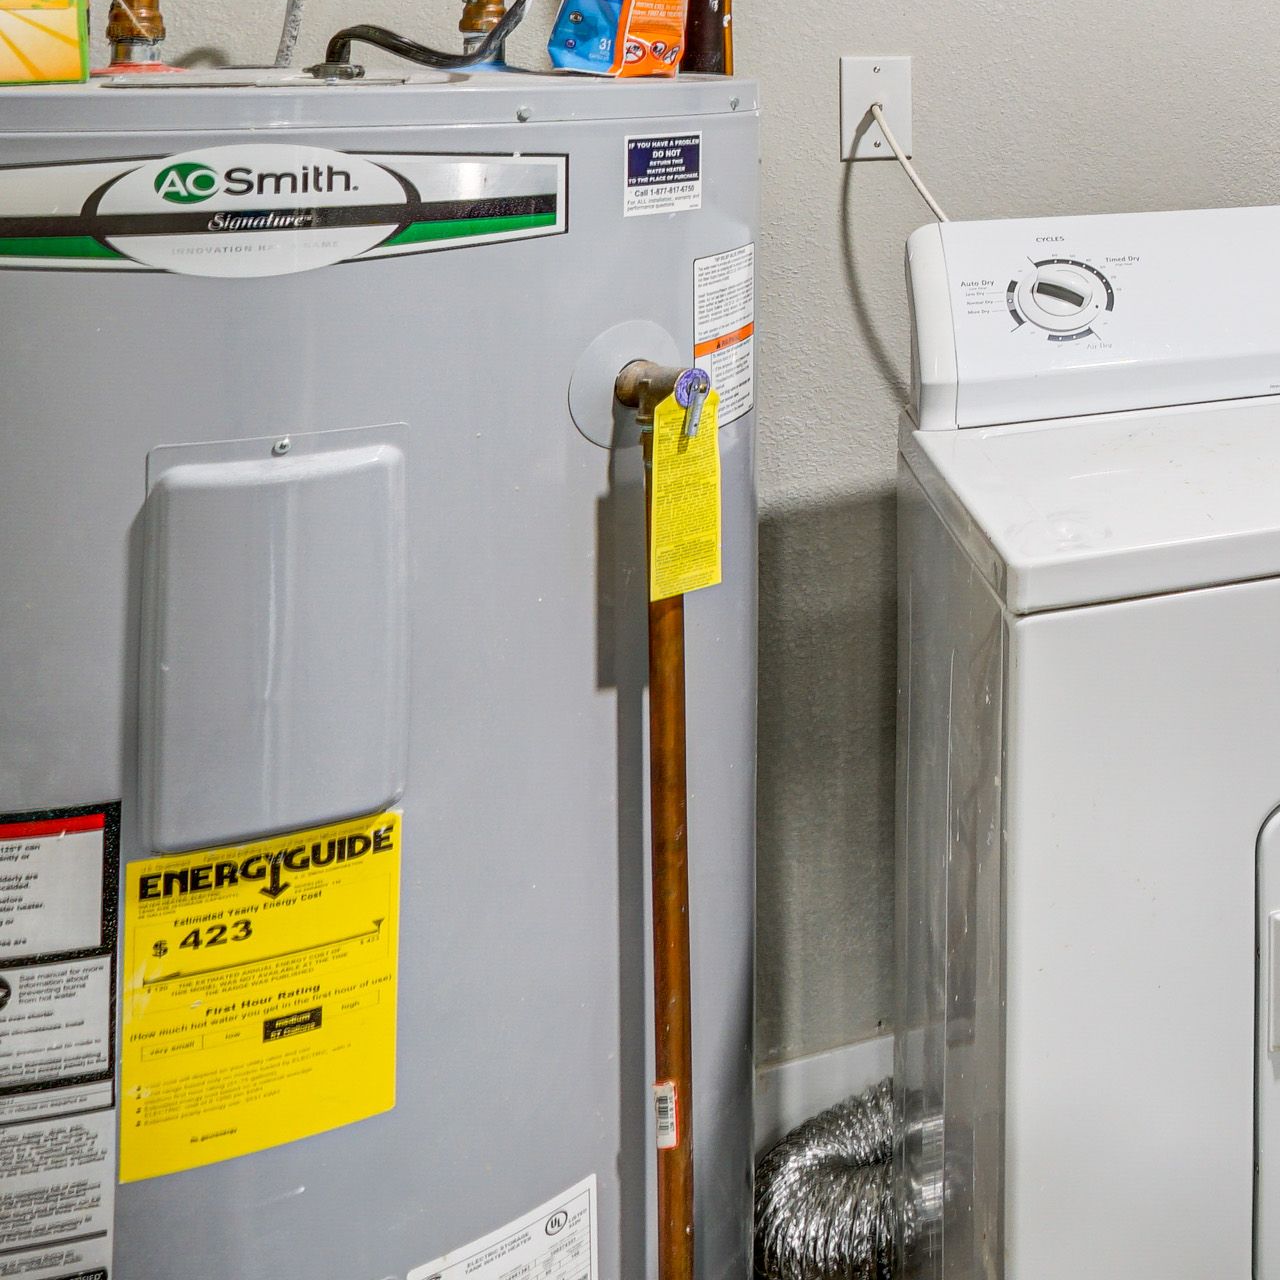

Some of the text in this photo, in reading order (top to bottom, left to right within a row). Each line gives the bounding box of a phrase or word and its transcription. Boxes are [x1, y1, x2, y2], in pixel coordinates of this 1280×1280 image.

[599, 39, 611, 50] 31
[666, 149, 681, 157] NOT
[1128, 255, 1140, 263] Dry
[981, 279, 995, 287] Dry
[1099, 342, 1112, 350] Dry
[173, 908, 224, 928] Estimated
[227, 903, 259, 919] Yearly
[263, 896, 297, 912] Energy
[300, 890, 322, 902] Cost
[151, 918, 253, 959] $ 423
[275, 956, 308, 967] ENERGY
[19, 975, 35, 983] See
[37, 971, 67, 980] manual
[83, 965, 104, 973] more
[19, 975, 89, 990] information about
[19, 987, 61, 998] preventing
[205, 983, 321, 1017] First Hour Rating
[129, 974, 392, 1043] (How much hot water you get in the first hour of use)
[275, 1013, 311, 1028] medium
[149, 1000, 360, 1057] very small low high
[550, 1217, 563, 1229] UL
[467, 1249, 498, 1268] ELECTRIC
[500, 1232, 530, 1251] STORAGE
[483, 1252, 506, 1266] WATER
[507, 1236, 532, 1255] HEATER
